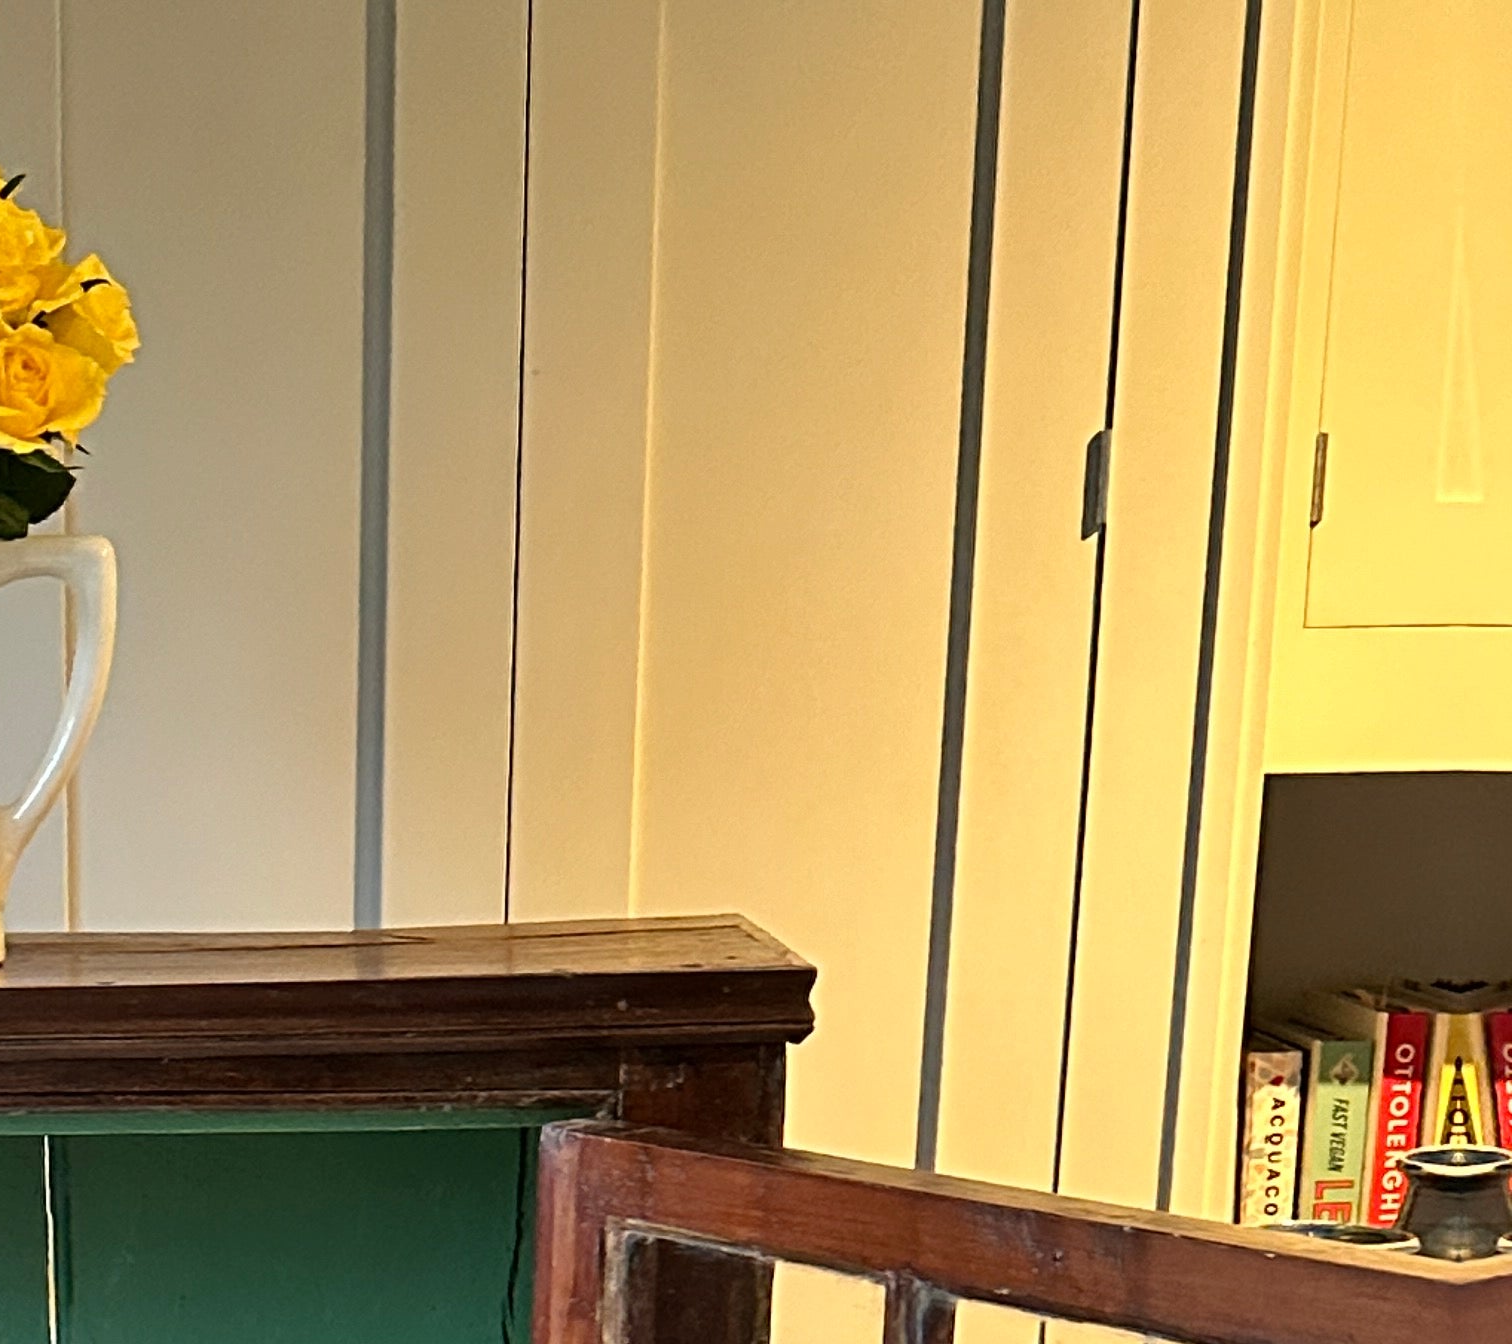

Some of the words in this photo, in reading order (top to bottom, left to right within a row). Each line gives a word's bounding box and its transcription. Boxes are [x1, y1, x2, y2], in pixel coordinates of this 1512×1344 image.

[1330, 1097, 1351, 1130] FAST
[1263, 1096, 1286, 1217] ACQUACO
[1328, 1131, 1350, 1173] VEGAN
